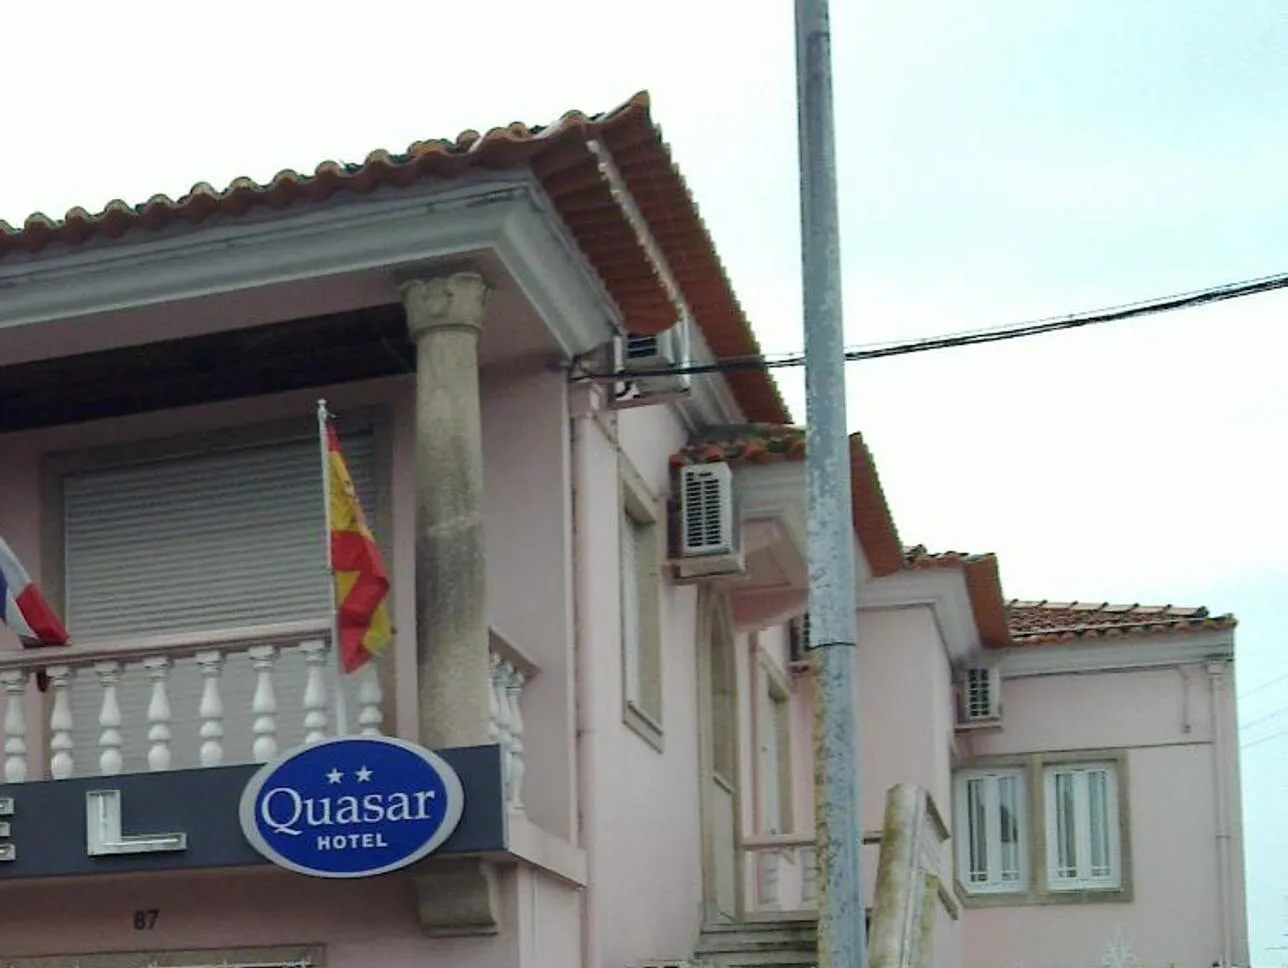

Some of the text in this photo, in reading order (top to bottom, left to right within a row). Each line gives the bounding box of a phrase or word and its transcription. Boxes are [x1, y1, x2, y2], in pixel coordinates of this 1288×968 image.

[261, 787, 436, 836] Quasar
[317, 832, 389, 851] HOTEL
[133, 909, 160, 931] 87
